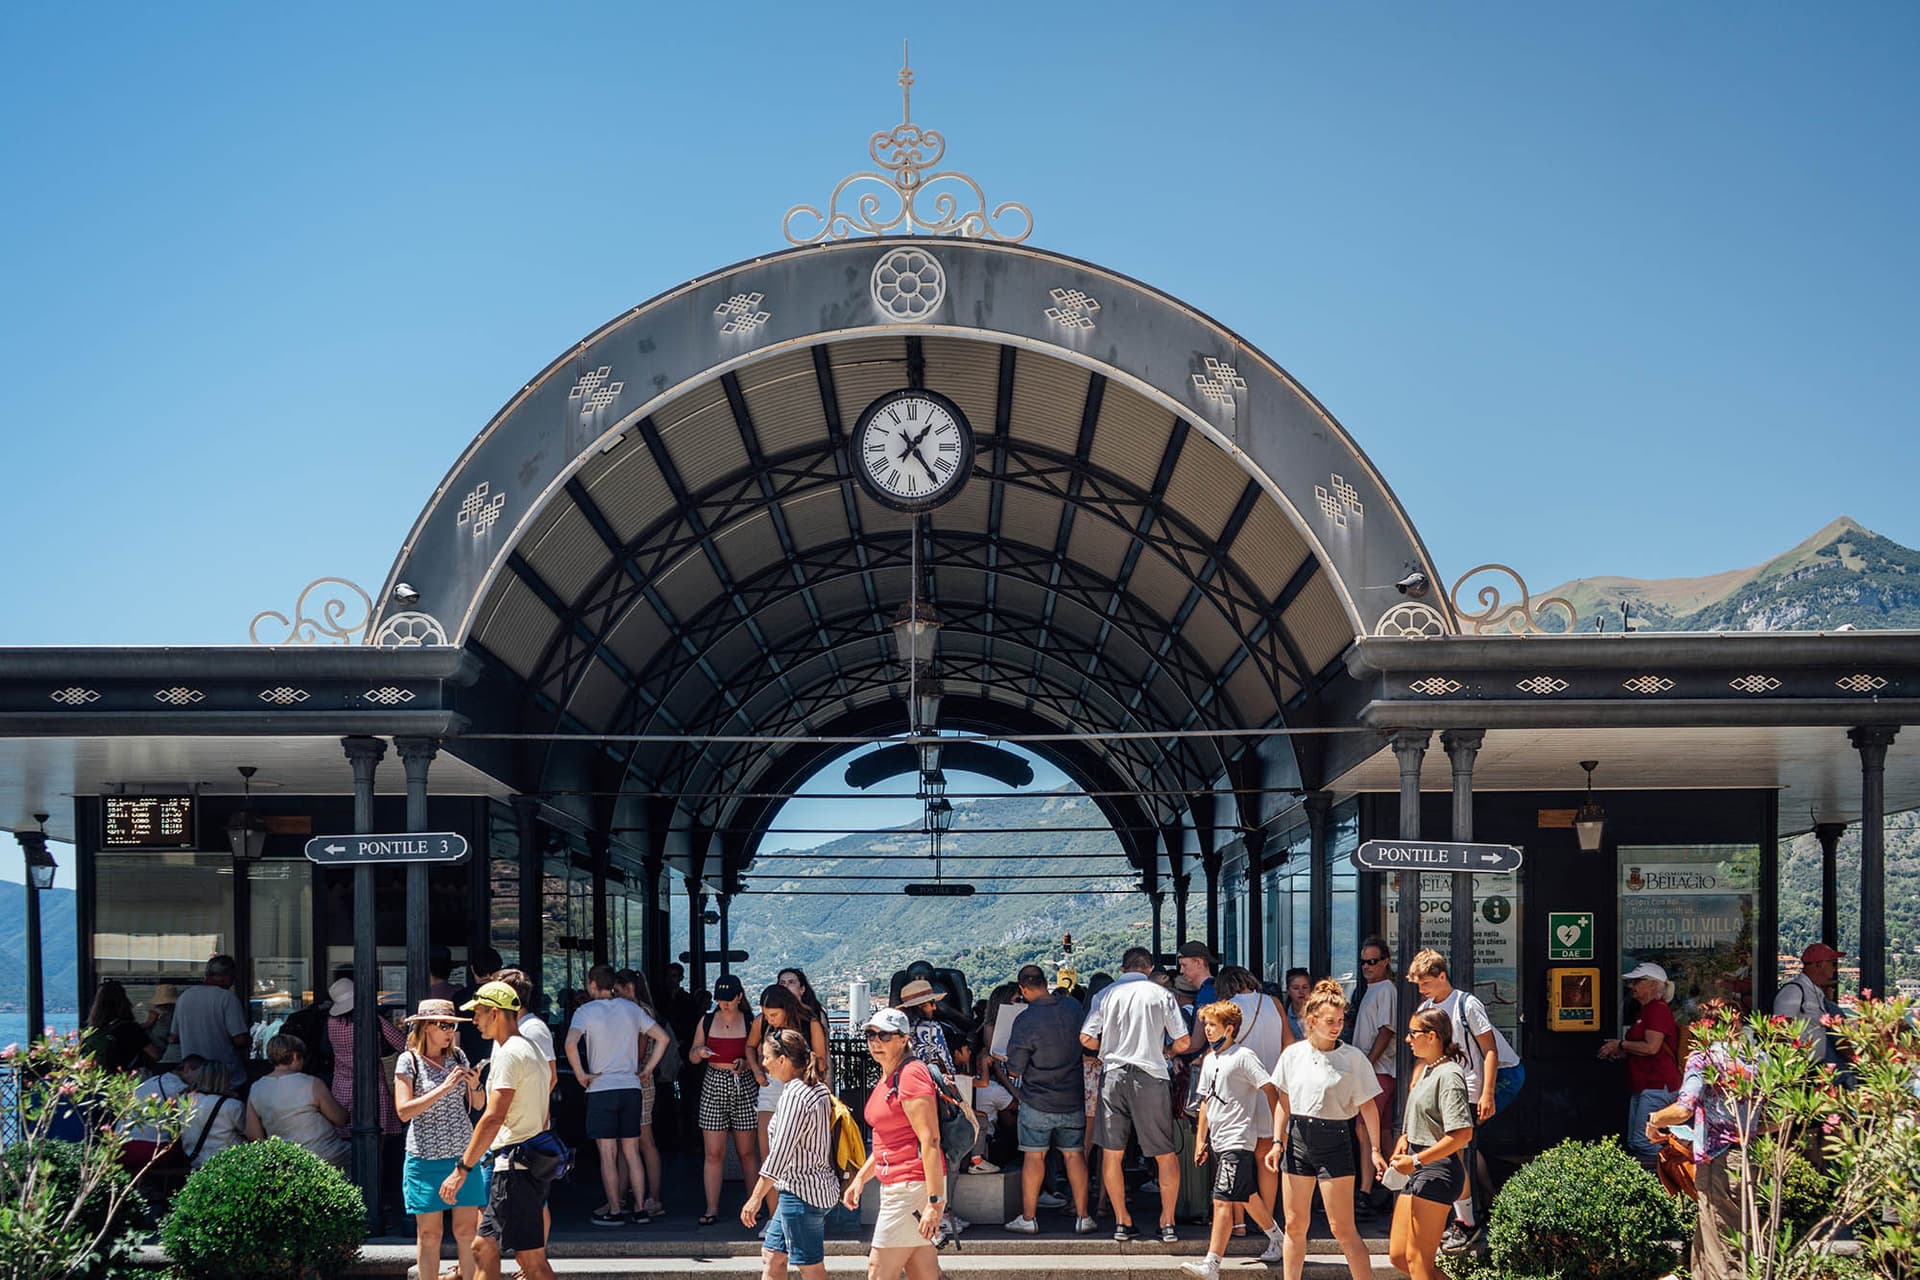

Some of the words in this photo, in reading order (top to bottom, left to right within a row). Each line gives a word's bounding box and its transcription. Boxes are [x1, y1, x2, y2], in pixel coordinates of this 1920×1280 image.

[358, 840, 428, 856] PONTILE
[440, 840, 449, 854] 3
[1378, 847, 1449, 863] PONTILE
[1462, 851, 1468, 864] 1
[1389, 900, 1480, 913] iOPOT
[1626, 918, 1676, 933] PARCO
[1682, 918, 1696, 932] DI
[1701, 917, 1742, 932] VILLA
[1626, 934, 1716, 949] SERBELLONI
[1561, 950, 1580, 958] DAE
